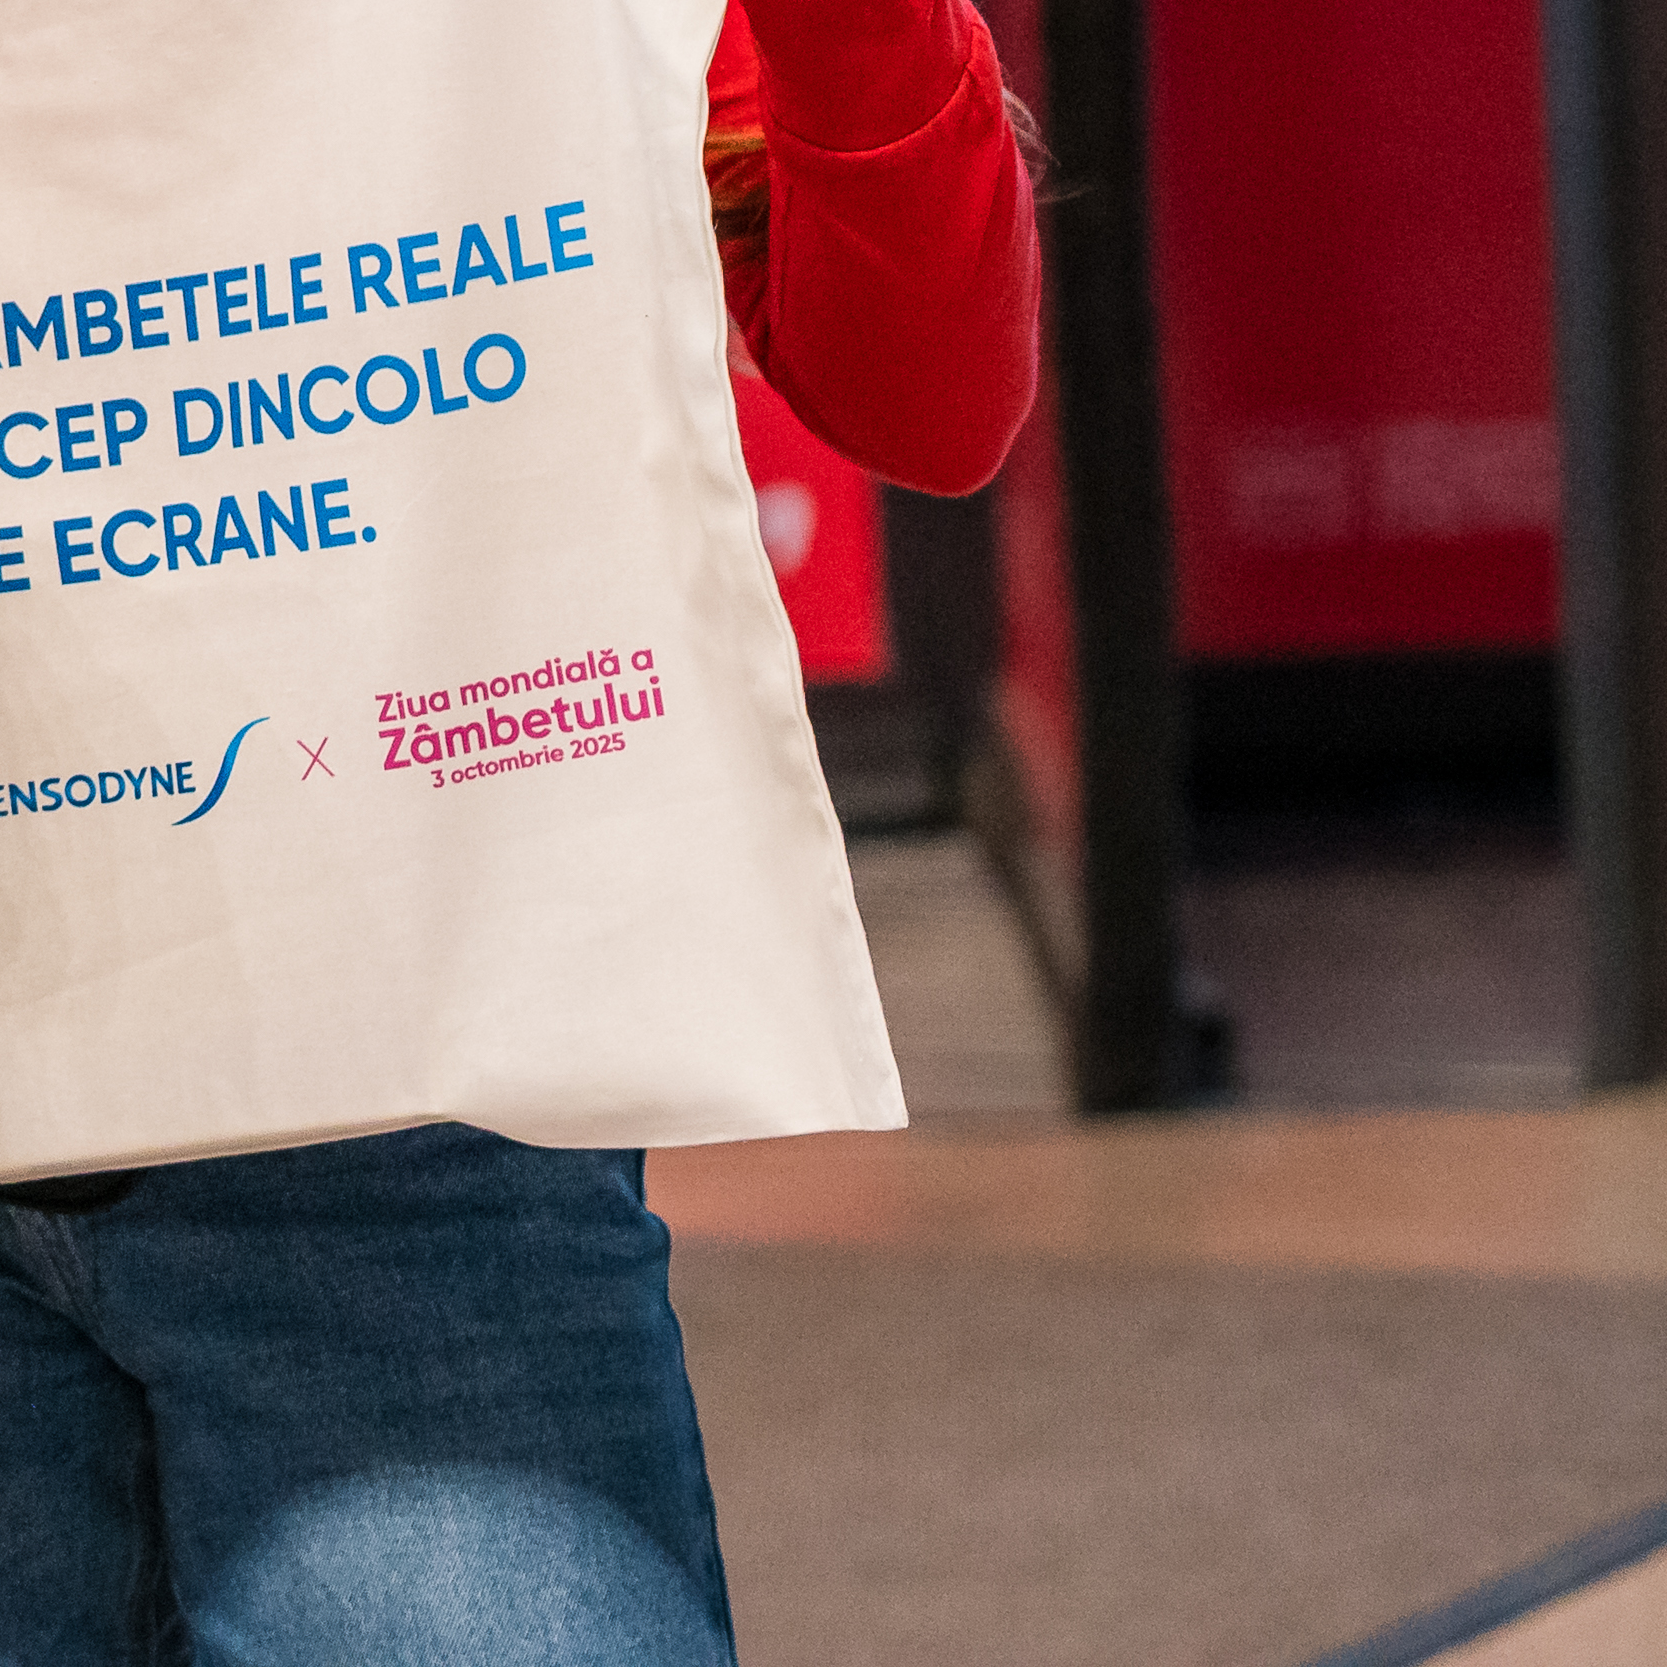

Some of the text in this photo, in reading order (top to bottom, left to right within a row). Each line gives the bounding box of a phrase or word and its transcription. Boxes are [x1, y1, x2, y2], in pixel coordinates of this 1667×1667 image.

[347, 199, 595, 314] REALE
[172, 332, 527, 457] DINCOLO
[53, 477, 378, 586] ECRANE.
[374, 647, 654, 723] Ziua mondială a
[378, 675, 665, 771] Zâmbetului
[430, 731, 626, 789] 3 octombrie 2025
